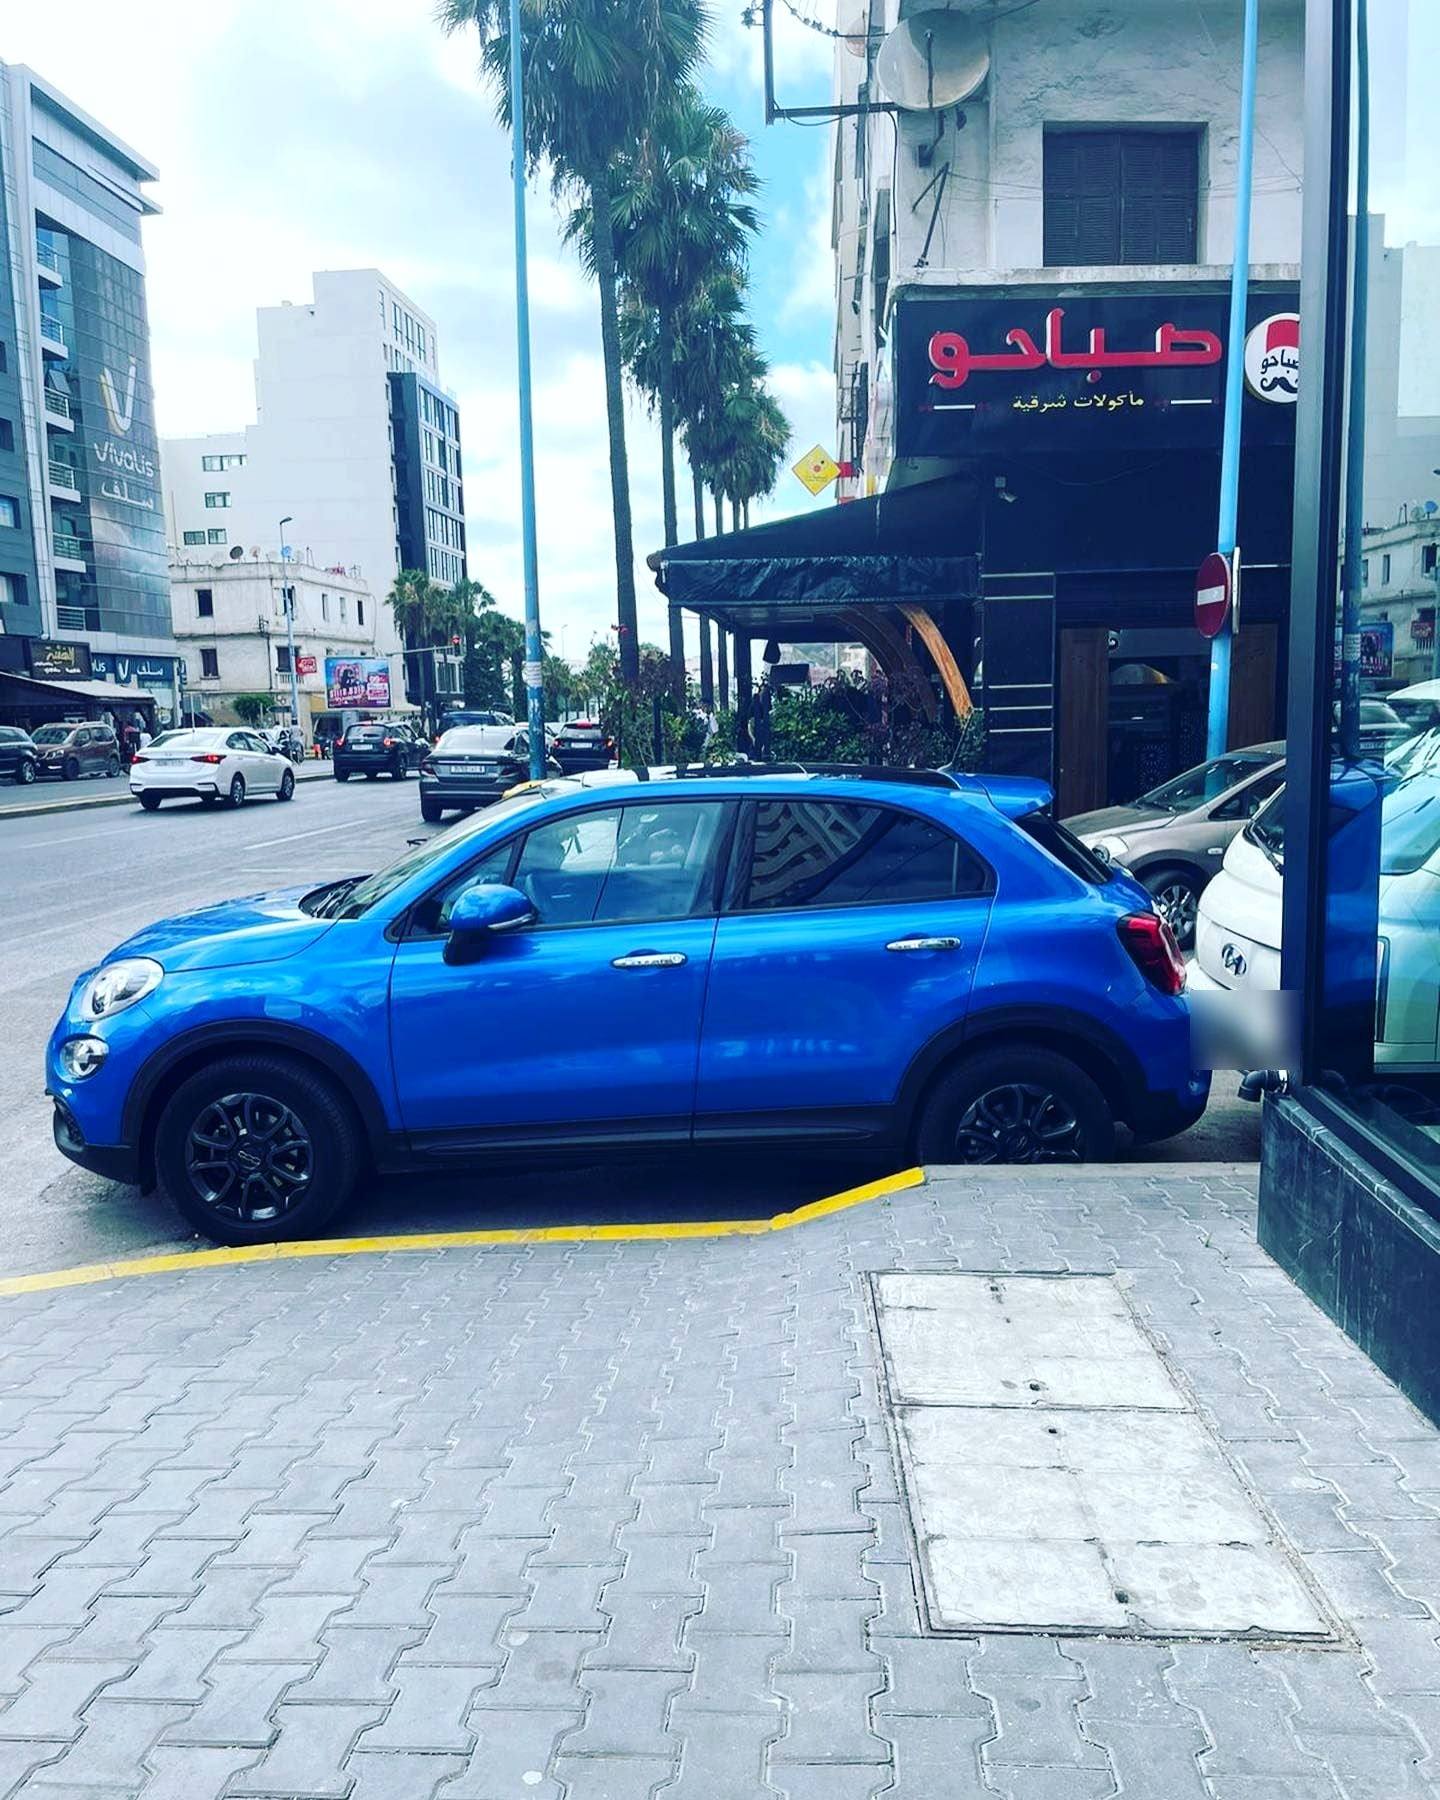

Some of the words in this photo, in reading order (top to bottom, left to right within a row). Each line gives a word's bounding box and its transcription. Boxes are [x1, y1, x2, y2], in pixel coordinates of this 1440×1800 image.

[928, 307, 1223, 389] صباحو
[1012, 394, 1067, 413] شرقية
[1073, 390, 1145, 411] مأكولات
[101, 478, 154, 510] سلف
